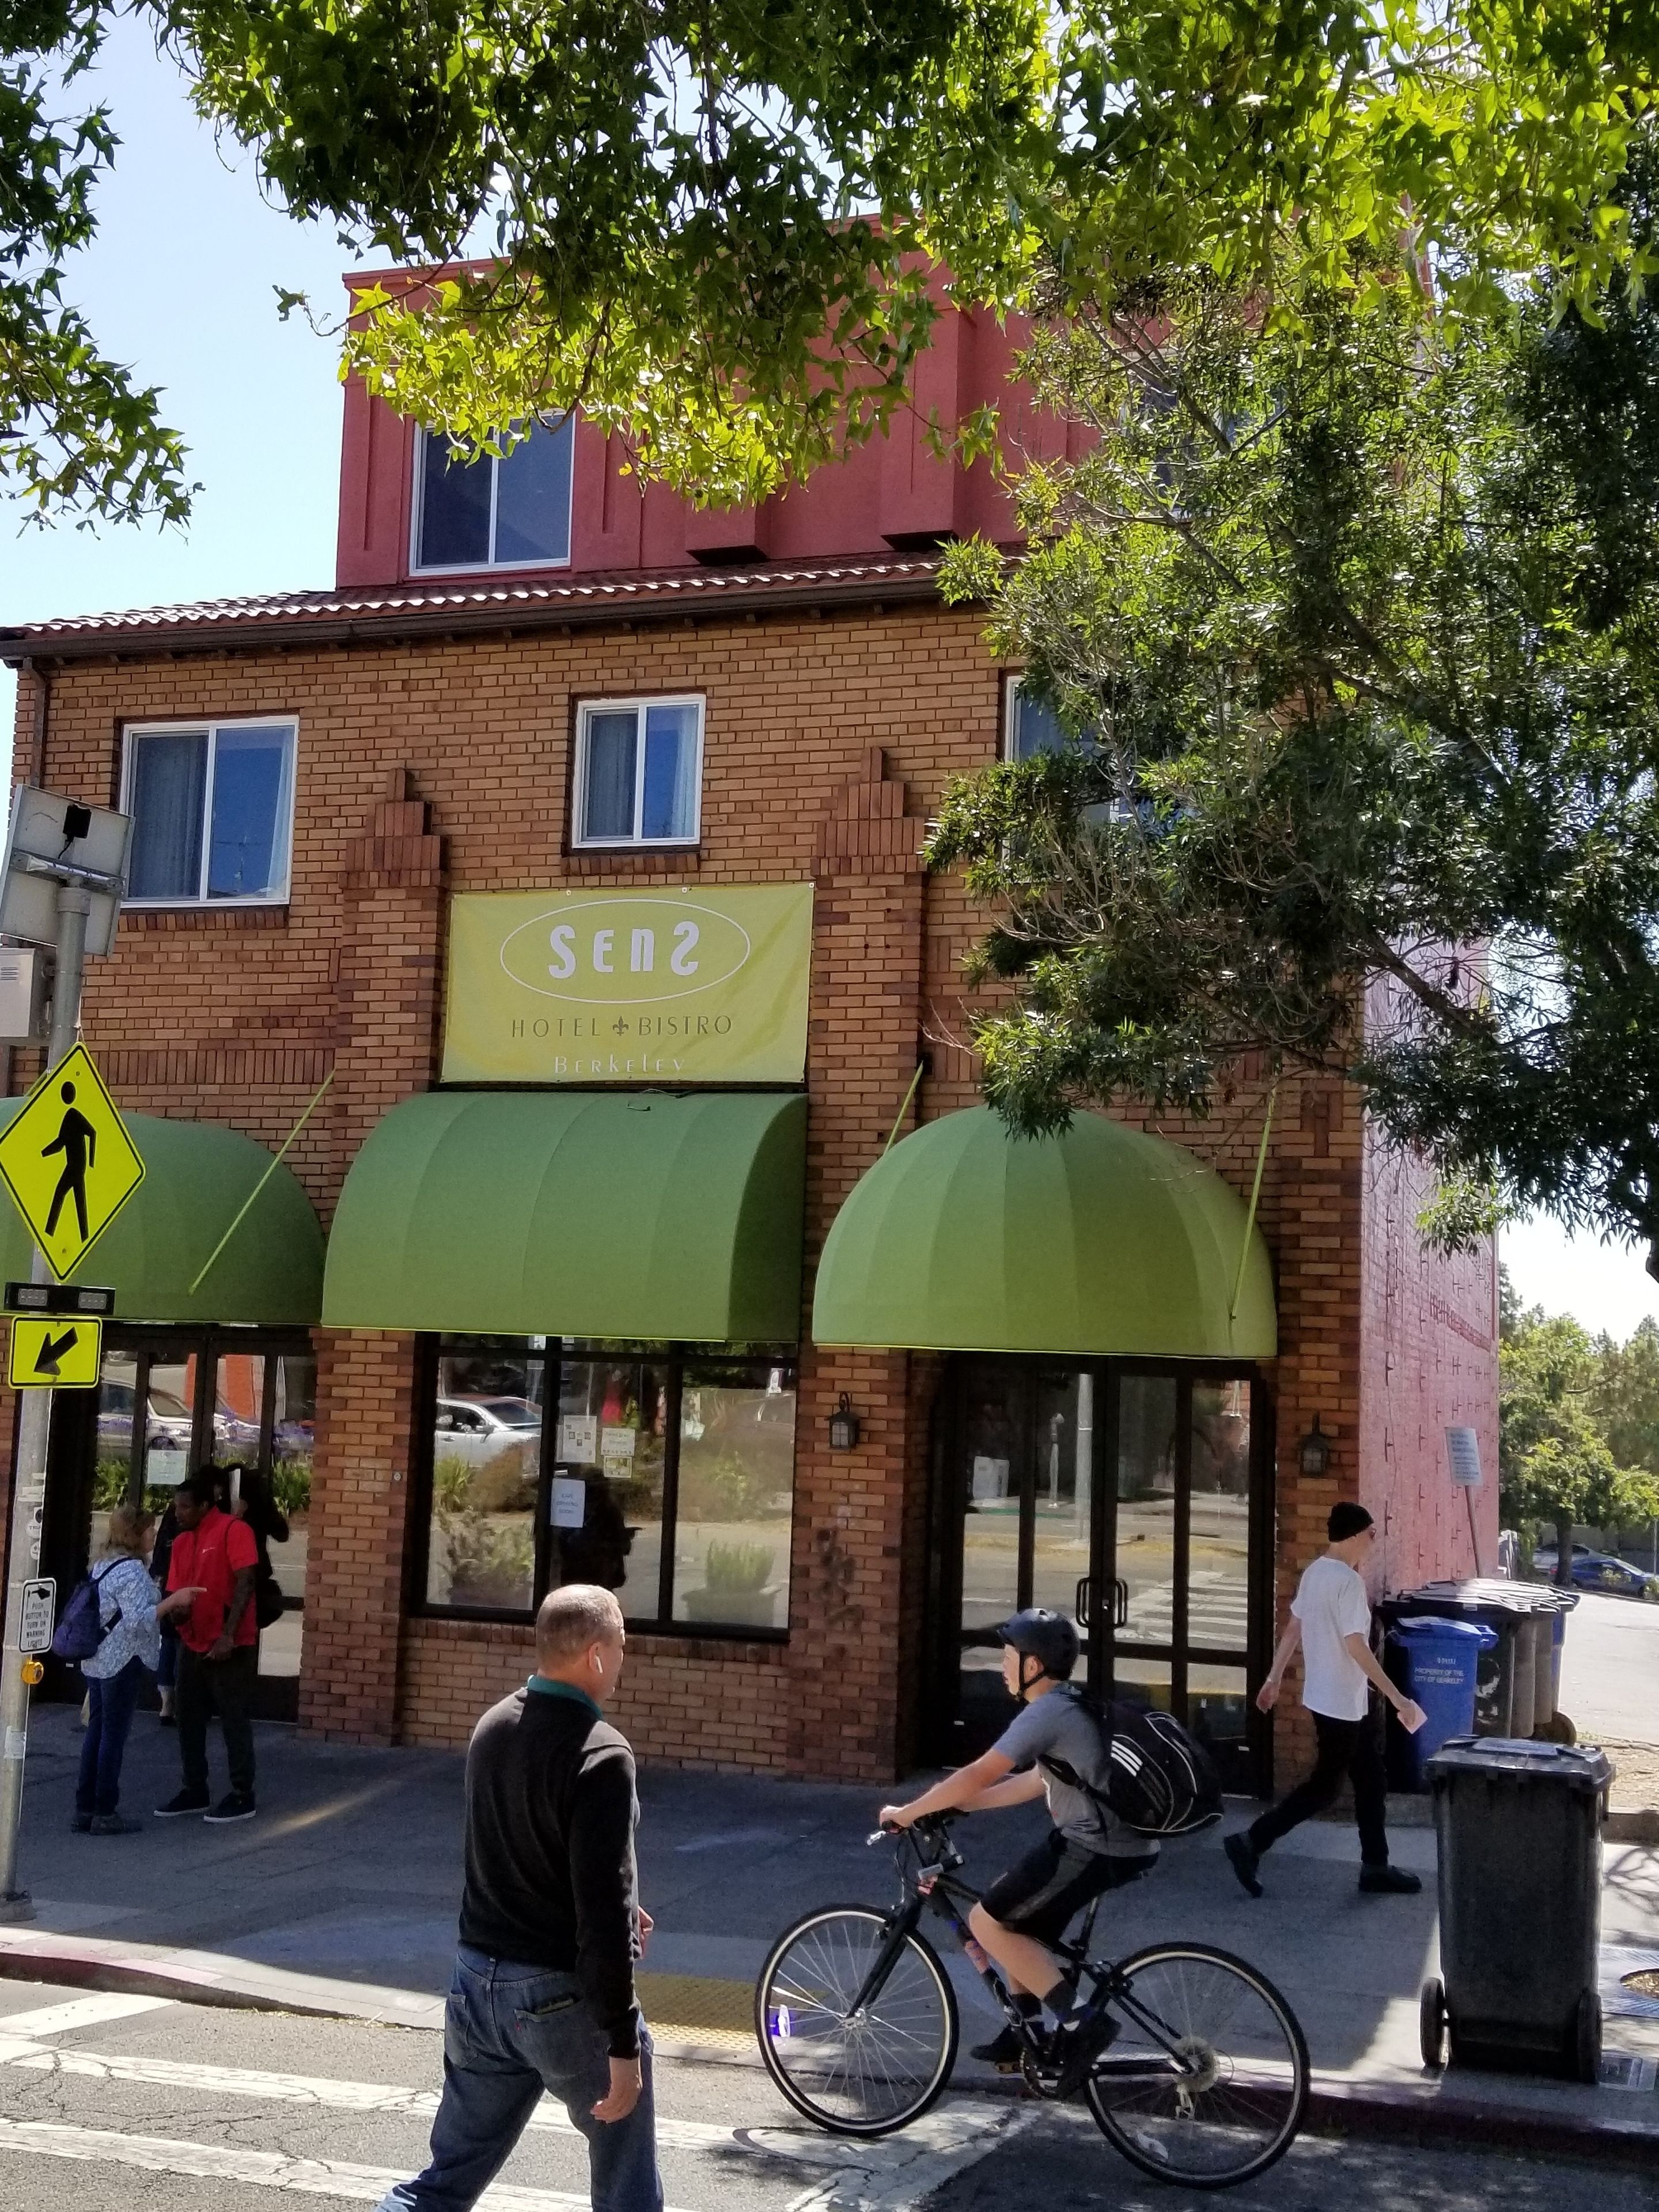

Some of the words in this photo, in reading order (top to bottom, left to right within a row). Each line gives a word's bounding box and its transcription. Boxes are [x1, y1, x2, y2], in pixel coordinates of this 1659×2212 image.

[512, 1017, 601, 1037] HOTEL
[638, 1015, 732, 1036] BISTRO
[32, 1602, 44, 1610] PUSH
[25, 1612, 42, 1620] BUTTON
[43, 1610, 50, 1618] TO
[27, 1621, 39, 1629] TURN
[26, 1629, 46, 1638] WARNING
[28, 1638, 43, 1648] LIGHTS
[1415, 1667, 1444, 1675] PROPERTY
